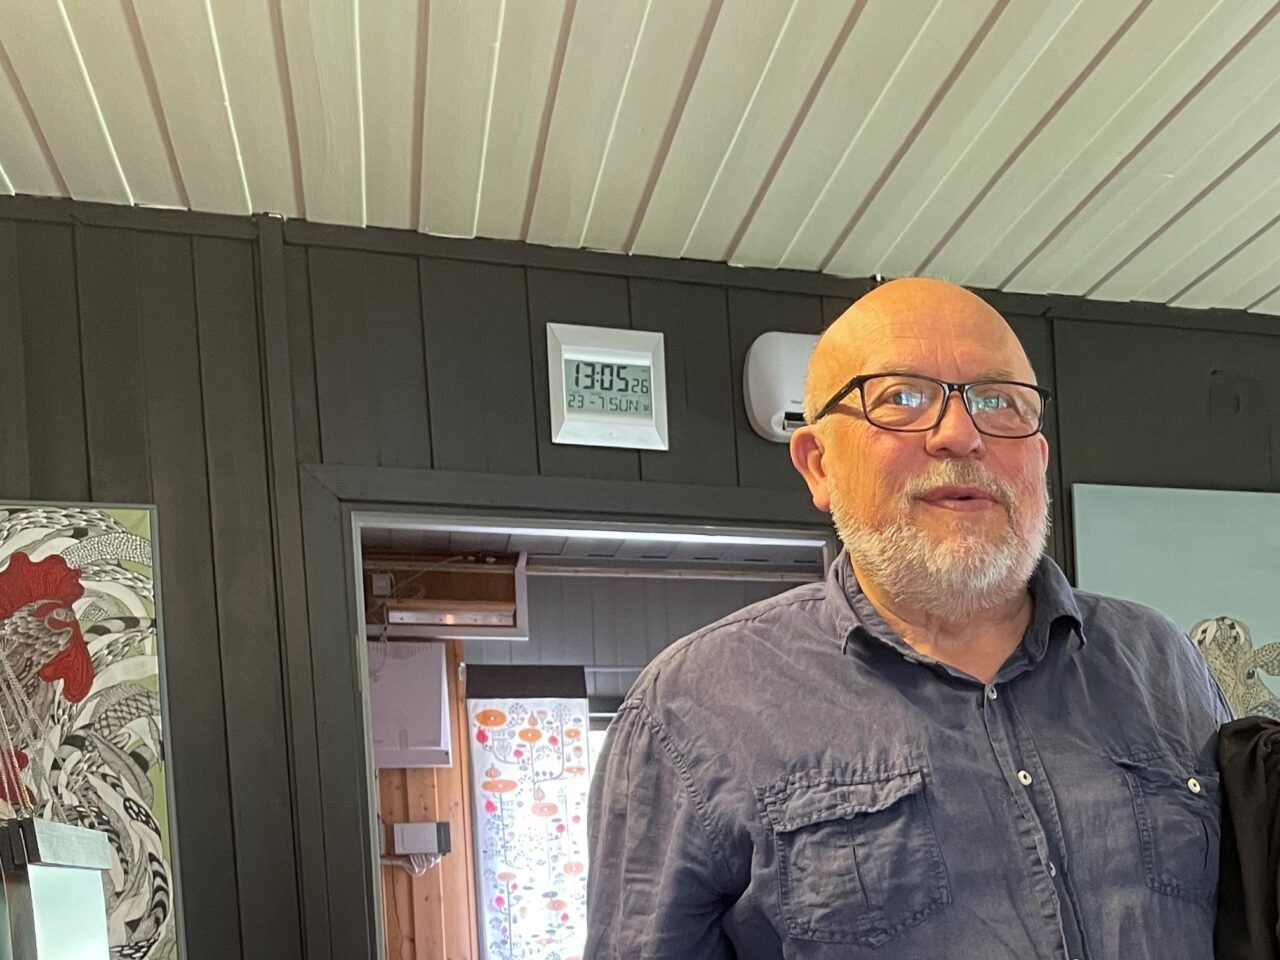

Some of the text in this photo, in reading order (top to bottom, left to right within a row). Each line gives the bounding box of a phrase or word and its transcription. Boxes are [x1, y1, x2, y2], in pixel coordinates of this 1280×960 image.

[575, 362, 649, 394] 13:05 26
[609, 397, 639, 412] SUN
